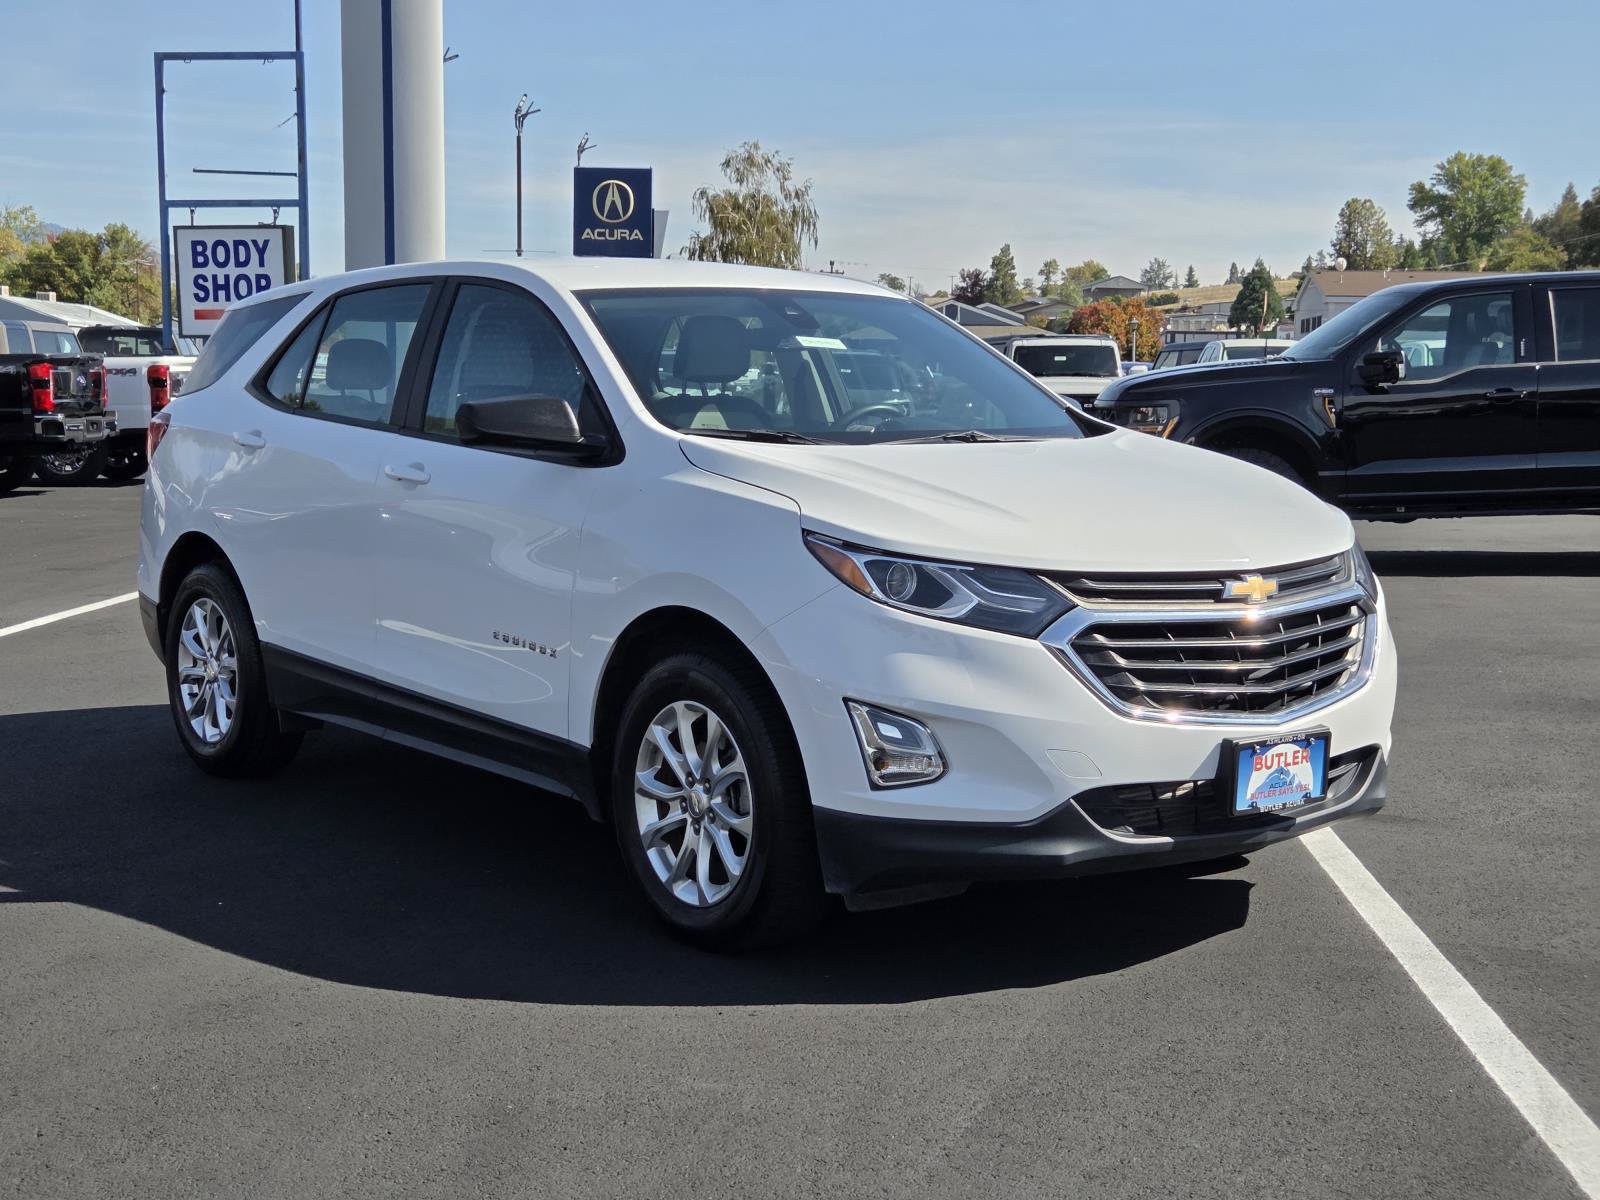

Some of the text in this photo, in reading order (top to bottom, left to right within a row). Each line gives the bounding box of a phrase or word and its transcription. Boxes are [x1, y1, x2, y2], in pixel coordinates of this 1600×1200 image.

[581, 228, 643, 240] ACURA
[191, 239, 270, 268] BODY
[193, 274, 271, 303] SHOP
[493, 631, 557, 658] EQUINOX
[1266, 736, 1293, 744] ASHLAND
[1254, 748, 1310, 772] BUTLER
[1269, 780, 1293, 789] ACURA
[1250, 789, 1276, 800] BUTLER
[1279, 786, 1294, 796] SAYS
[1260, 803, 1283, 812] BUTLER
